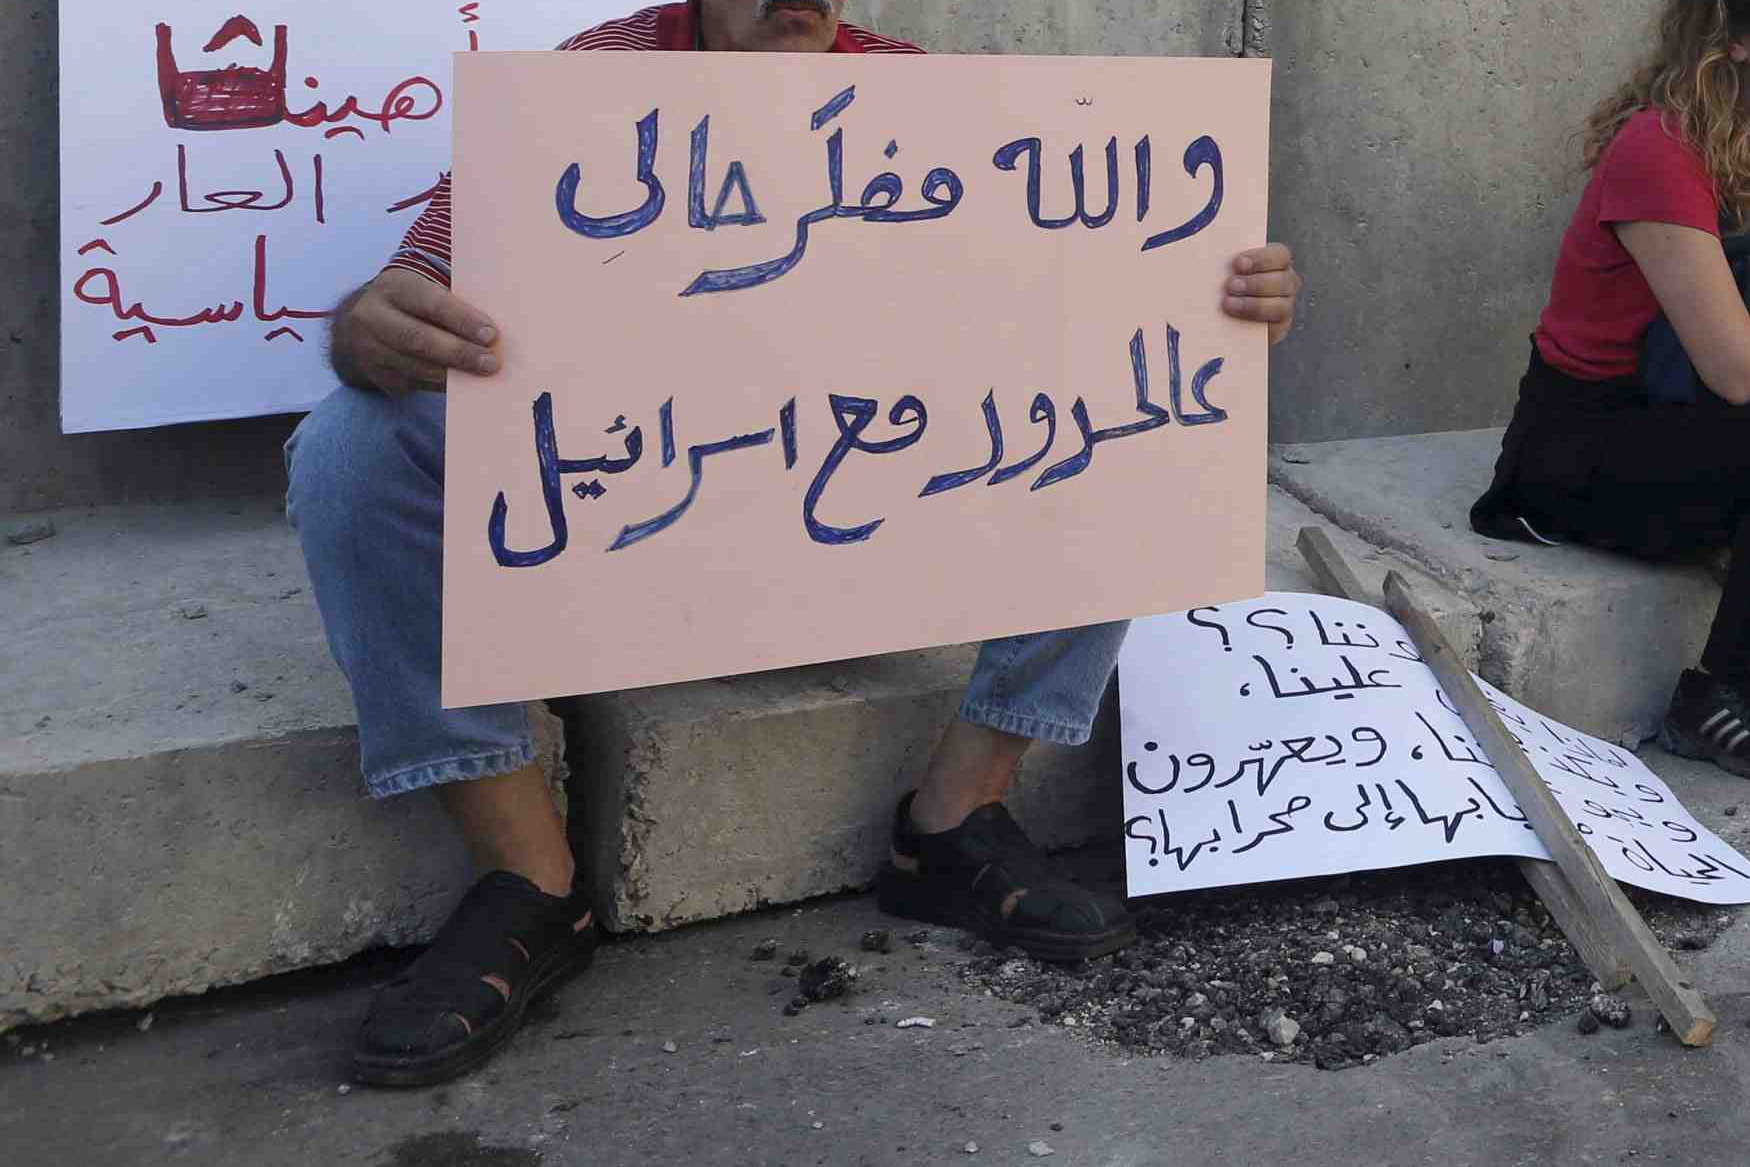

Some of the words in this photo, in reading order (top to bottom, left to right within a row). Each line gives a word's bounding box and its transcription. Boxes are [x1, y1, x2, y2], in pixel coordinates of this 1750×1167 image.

[100, 143, 326, 226] العار
[72, 233, 333, 345] ياسية
[802, 392, 930, 546] مع
[1322, 782, 1408, 833] إلى
